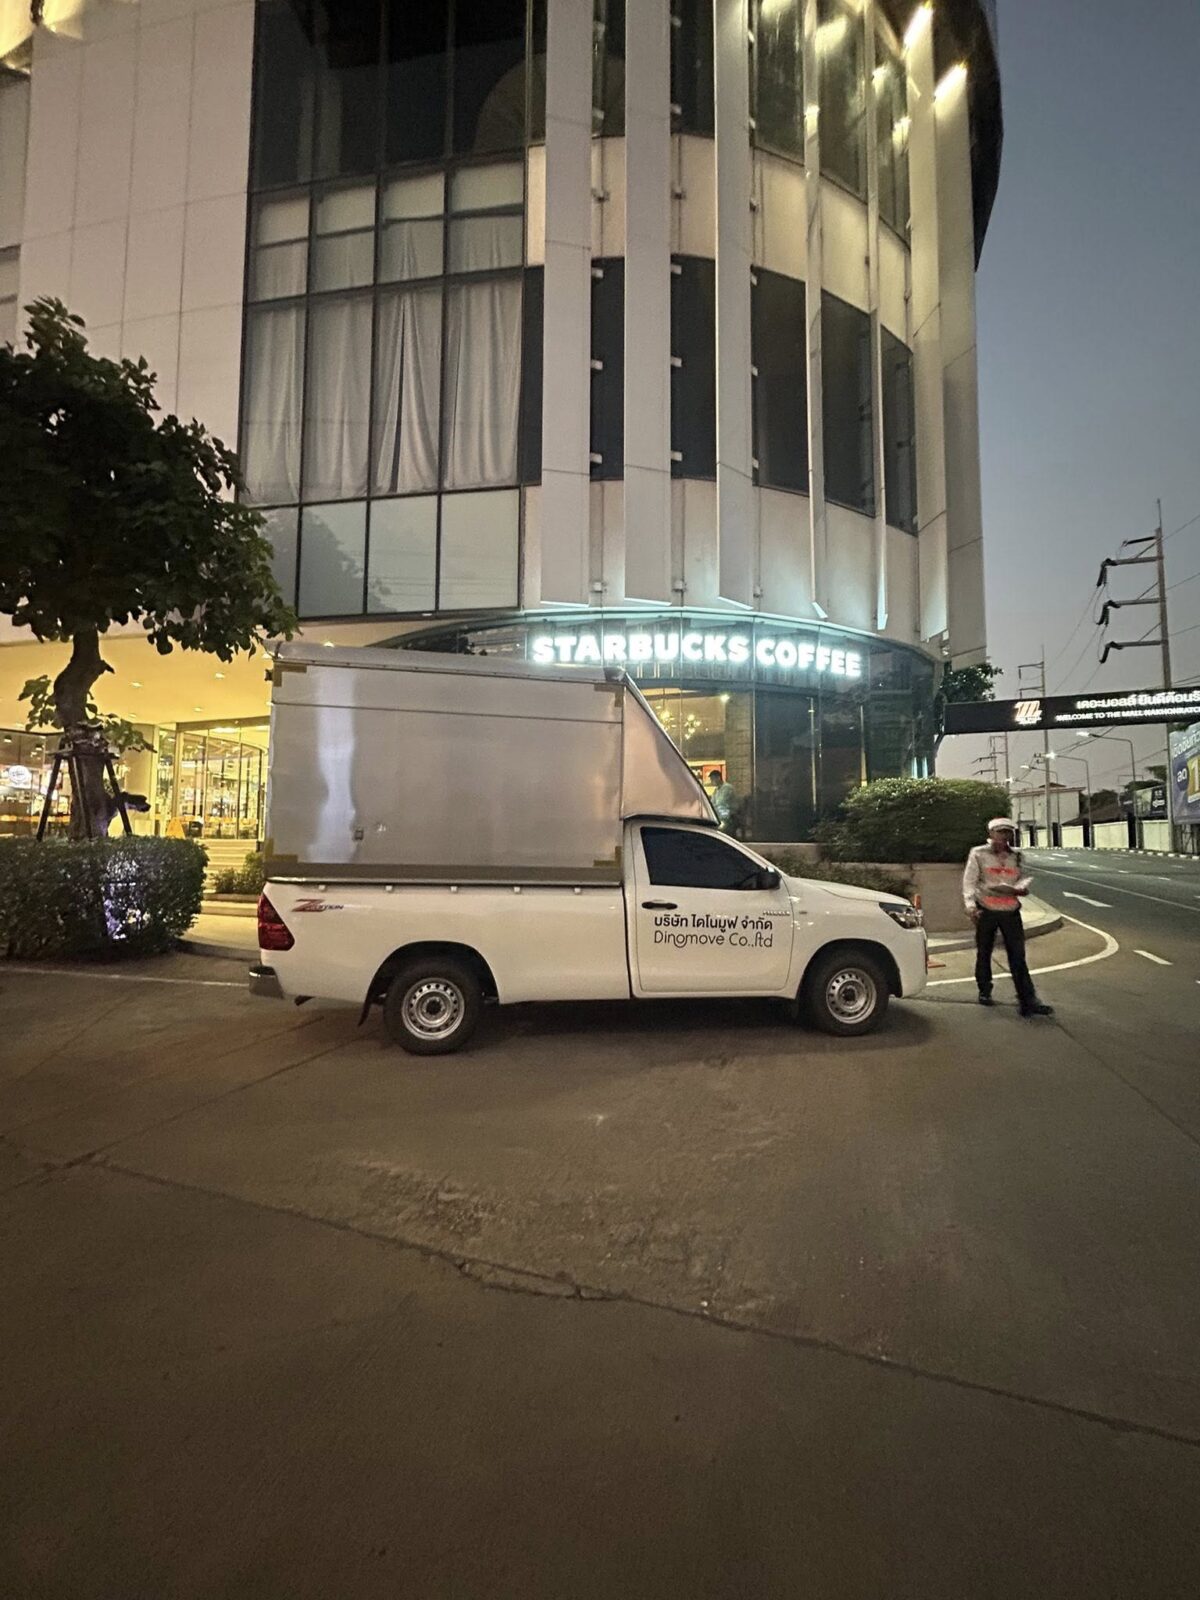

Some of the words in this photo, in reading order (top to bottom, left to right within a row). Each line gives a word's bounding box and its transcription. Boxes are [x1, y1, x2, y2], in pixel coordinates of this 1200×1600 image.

[532, 633, 749, 663] STARBUCKS
[755, 638, 862, 677] COFFEE
[1055, 712, 1093, 721] WELCOME
[654, 914, 688, 928] บริษัท
[691, 914, 738, 933] ไดโนมูฟ
[741, 915, 773, 930] จำกัด
[654, 930, 725, 948] Dinomove
